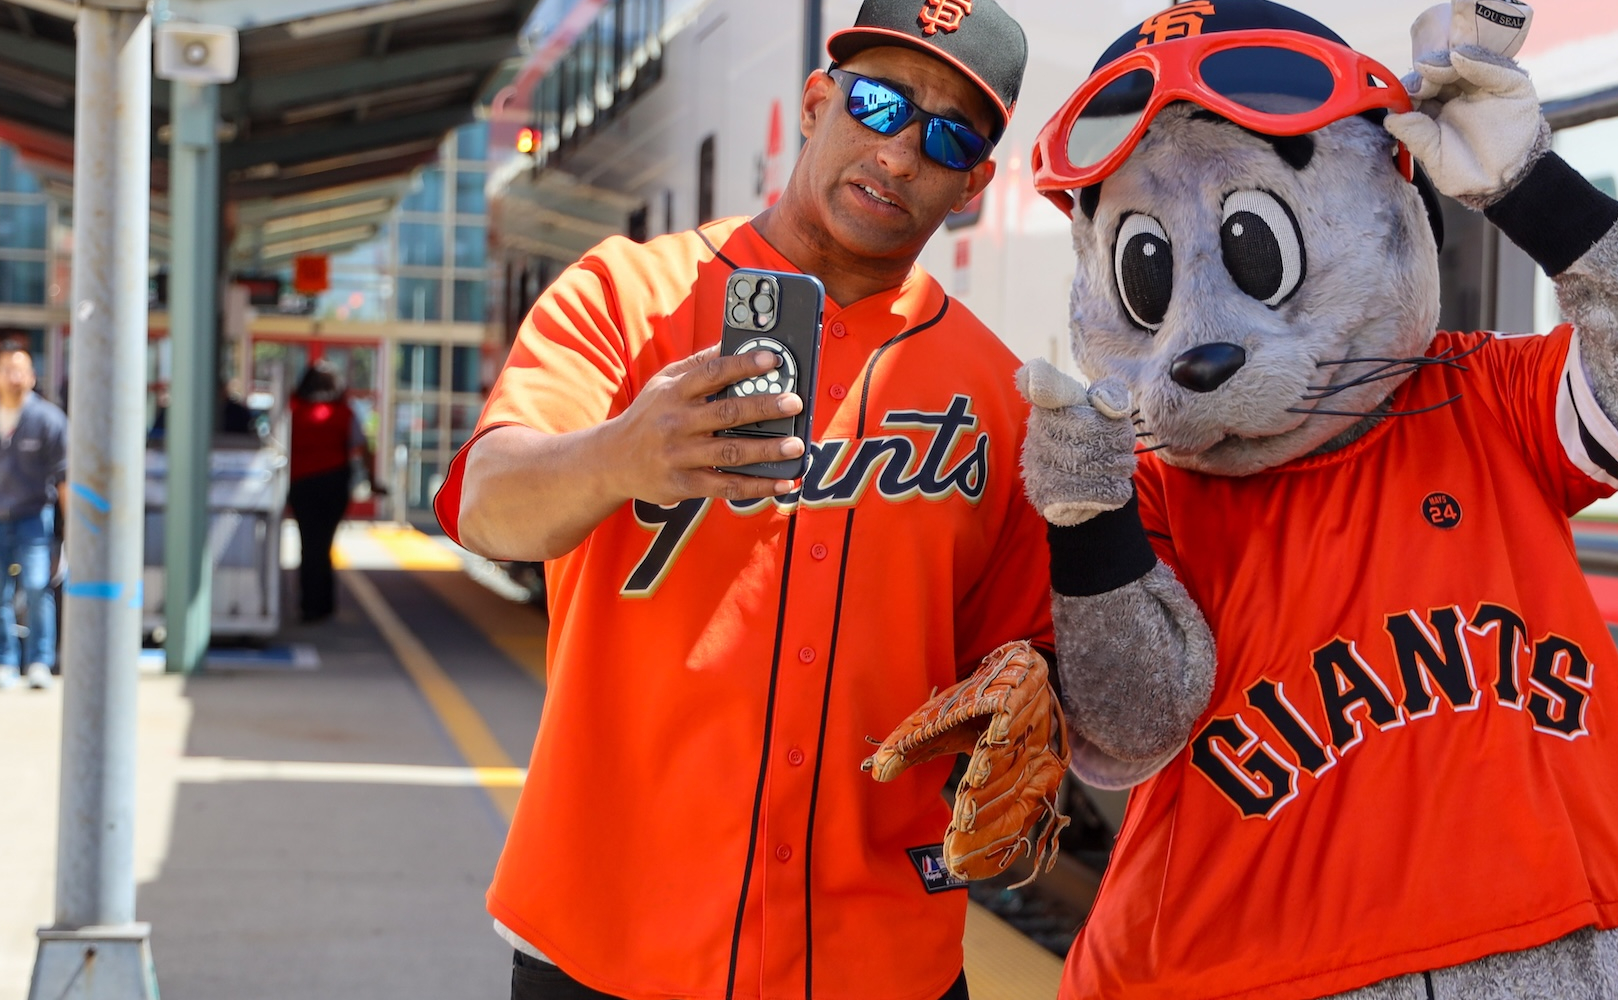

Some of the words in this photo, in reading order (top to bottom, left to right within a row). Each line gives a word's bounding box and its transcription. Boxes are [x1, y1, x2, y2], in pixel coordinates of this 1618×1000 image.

[1477, 6, 1498, 21] LOU
[1499, 16, 1523, 27] SEAL
[1429, 503, 1457, 523] 24
[1189, 601, 1595, 821] GIANTS
